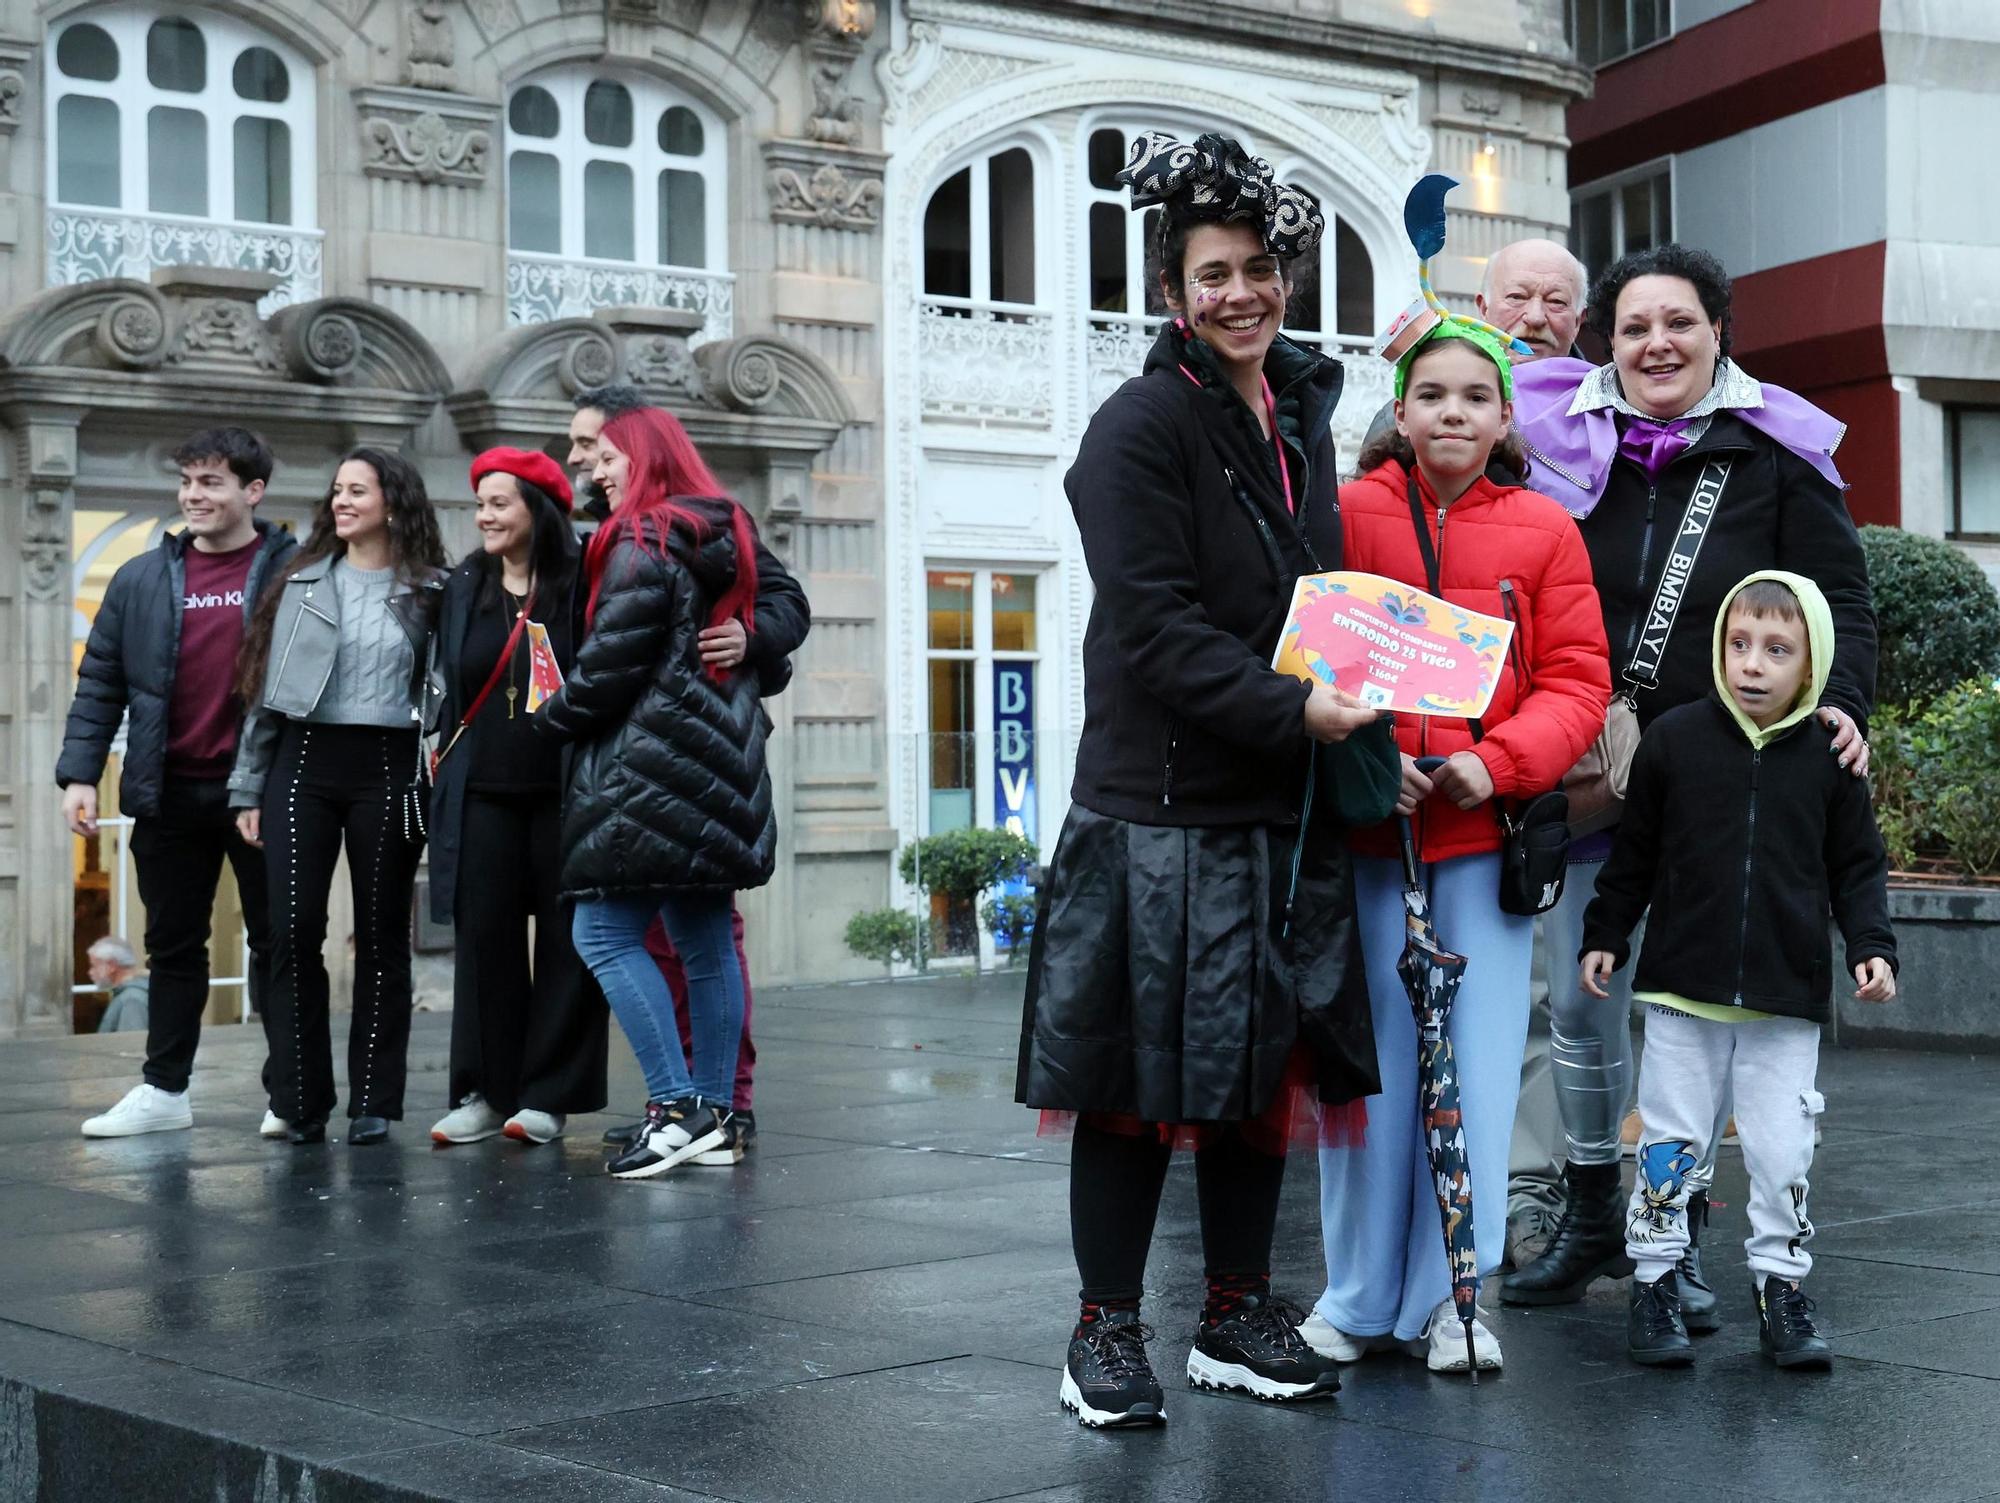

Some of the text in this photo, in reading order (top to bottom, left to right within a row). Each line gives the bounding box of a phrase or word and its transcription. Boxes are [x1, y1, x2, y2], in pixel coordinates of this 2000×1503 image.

[1682, 479, 1720, 535] LOLA
[183, 593, 223, 609] alvin
[1648, 553, 1692, 630] BIMBA
[1332, 612, 1457, 669] ENTROIDO 25 VIGO
[1349, 607, 1448, 653] CONCURSO DE COMPARSAS
